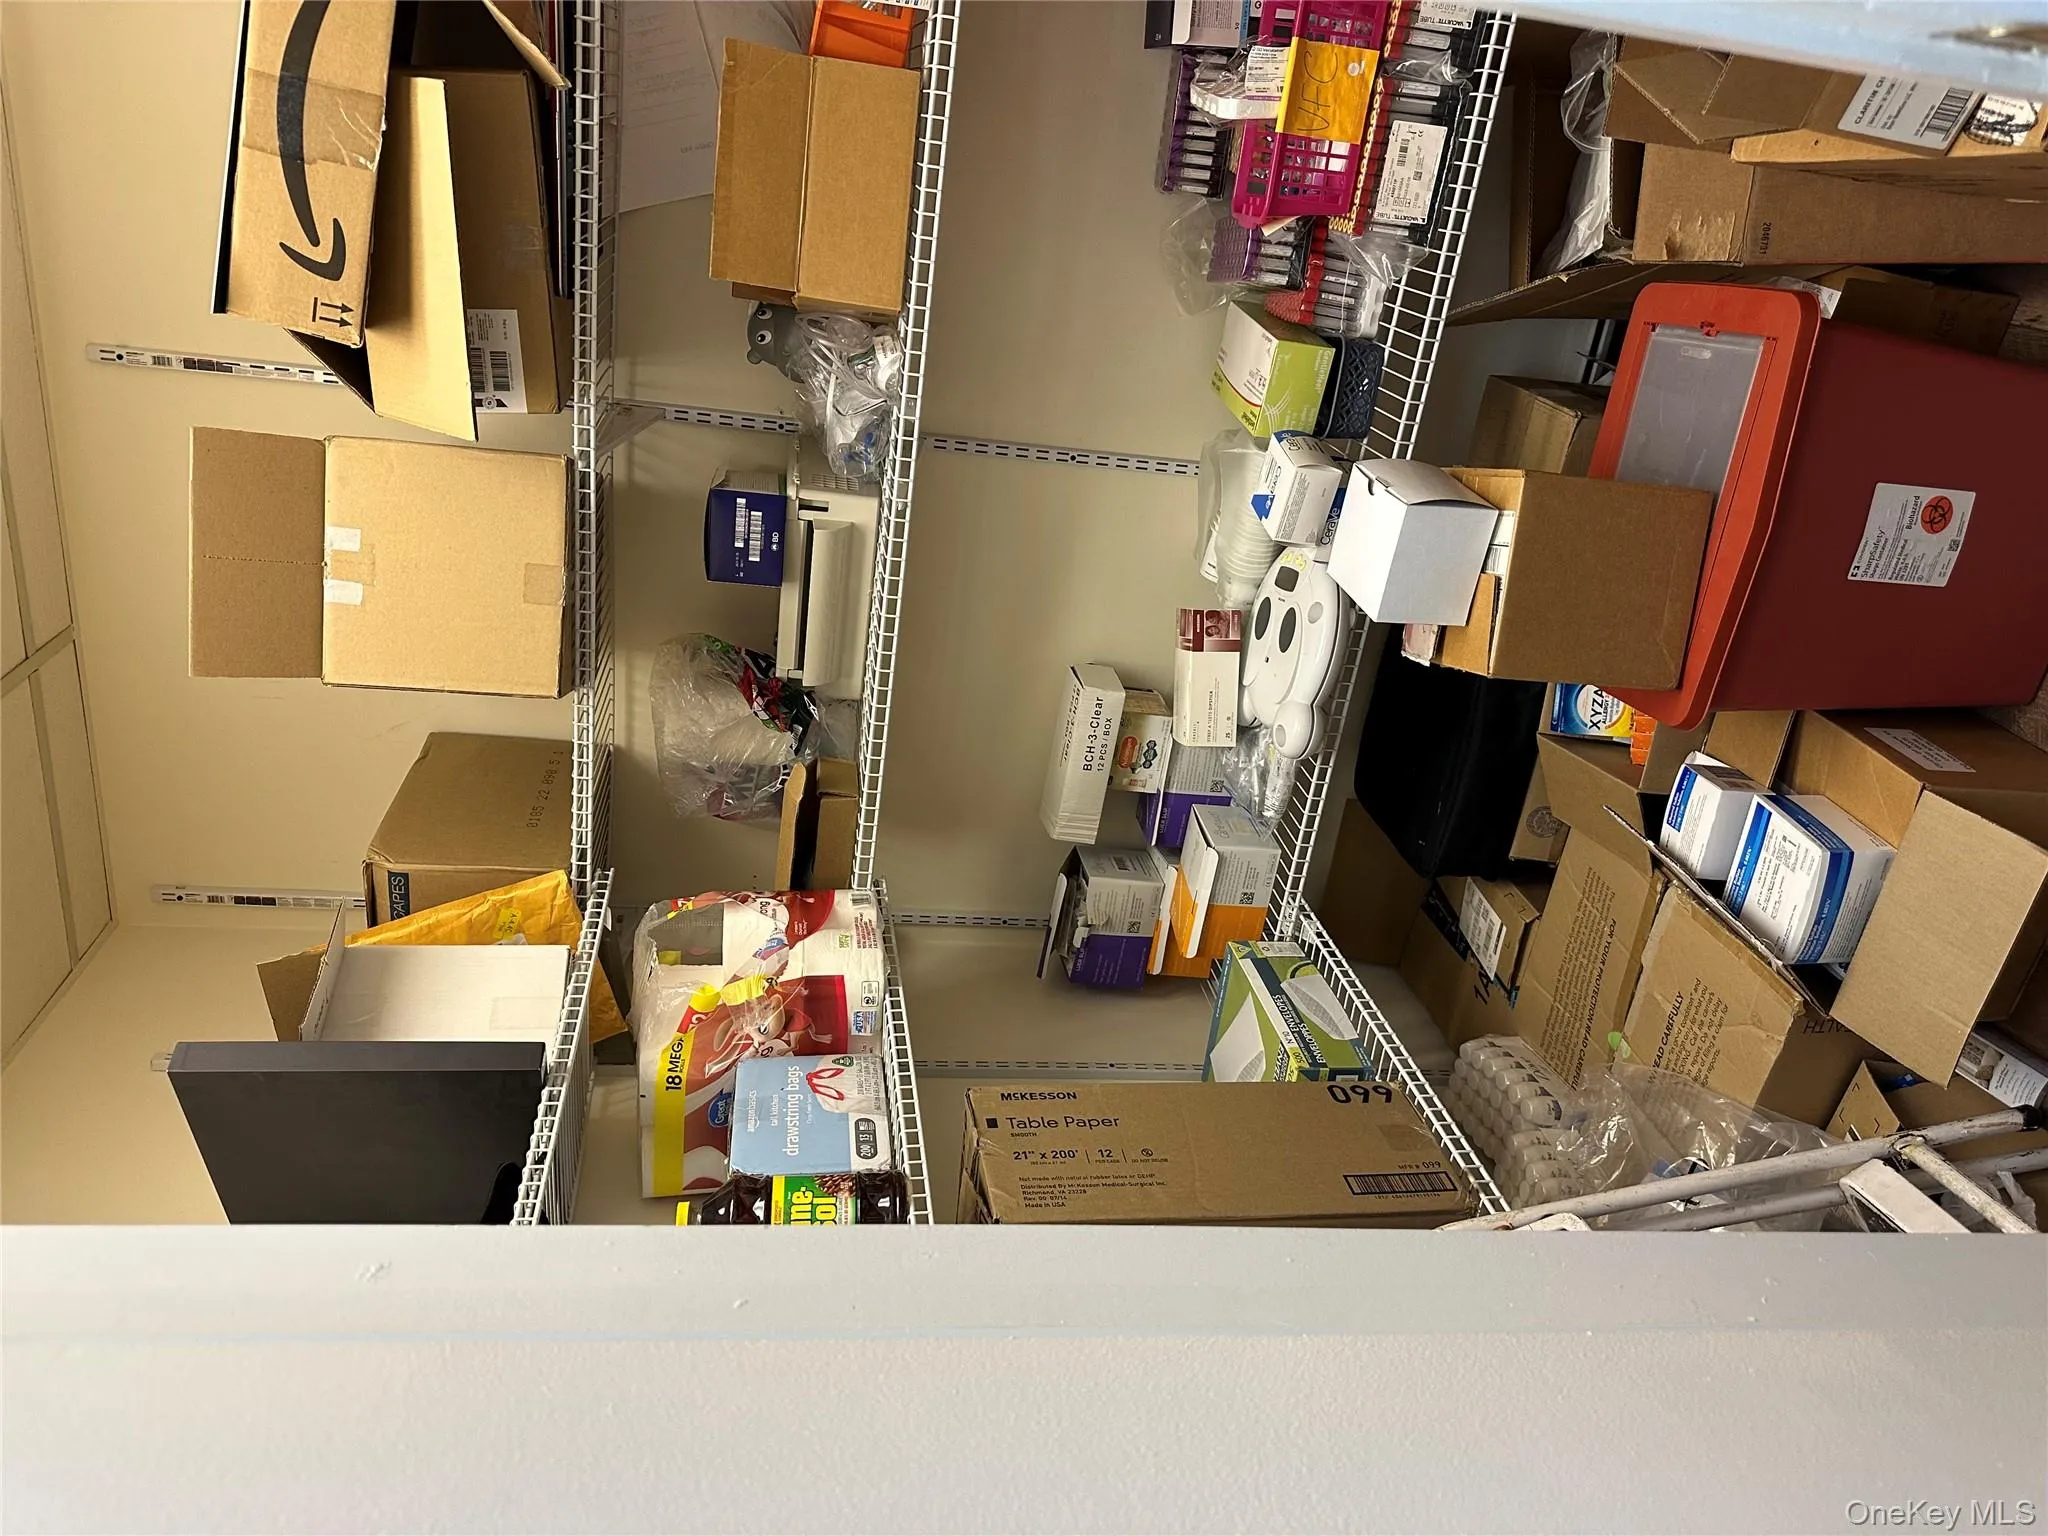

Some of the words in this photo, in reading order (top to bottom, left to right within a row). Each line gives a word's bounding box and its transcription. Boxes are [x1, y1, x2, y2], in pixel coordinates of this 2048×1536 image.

[1855, 89, 1879, 124] CLARITIN
[1905, 496, 1920, 529] Biohazard
[1321, 507, 1340, 546] CeraVe
[1602, 700, 1610, 724] ALLERGY
[1083, 696, 1104, 771] BCH-3-Clear
[1103, 718, 1112, 736] BOX
[1099, 743, 1108, 760] PCS
[1097, 762, 1105, 771] 12
[1604, 918, 1616, 939] FOR
[1600, 938, 1612, 968] YOUR
[1585, 967, 1603, 1023] PROTECTION
[1693, 978, 1701, 993] and
[1272, 994, 1298, 1032] ENVELOPES
[1684, 1025, 1694, 1041] only
[1693, 998, 1701, 1015] what
[1690, 1031, 1699, 1046] Call
[1703, 991, 1715, 1018] carrier's
[1580, 1024, 1592, 1049] READ
[1652, 1046, 1664, 1068] EAD
[1661, 991, 1684, 1046] CAREFULLY
[1691, 1046, 1702, 1068] report.
[1700, 1032, 1708, 1044] Do
[1712, 998, 1723, 1017] delay
[1700, 1058, 1706, 1067] of
[1703, 1041, 1715, 1058] filing
[1714, 1016, 1725, 1034] claim
[1721, 1004, 1729, 1016] for
[1298, 1023, 1326, 1063] ENVELOPPES
[1293, 1051, 1305, 1064] 500
[1706, 1050, 1720, 1074] reports.
[665, 1075, 682, 1091] 18
[783, 1066, 803, 1091] bags
[771, 1094, 779, 1115] kitchen
[1327, 1084, 1392, 1103] 099
[715, 1100, 726, 1123] Great
[746, 1090, 757, 1132] amazonbasics
[1005, 1116, 1059, 1129] Table
[1064, 1116, 1120, 1130] Paper
[782, 1094, 803, 1155] drawstring
[861, 1145, 871, 1157] 200
[1013, 1150, 1035, 1160] 21"
[1051, 1150, 1079, 1159] 200'
[1098, 1149, 1113, 1158] 12
[1422, 1161, 1441, 1169] 099
